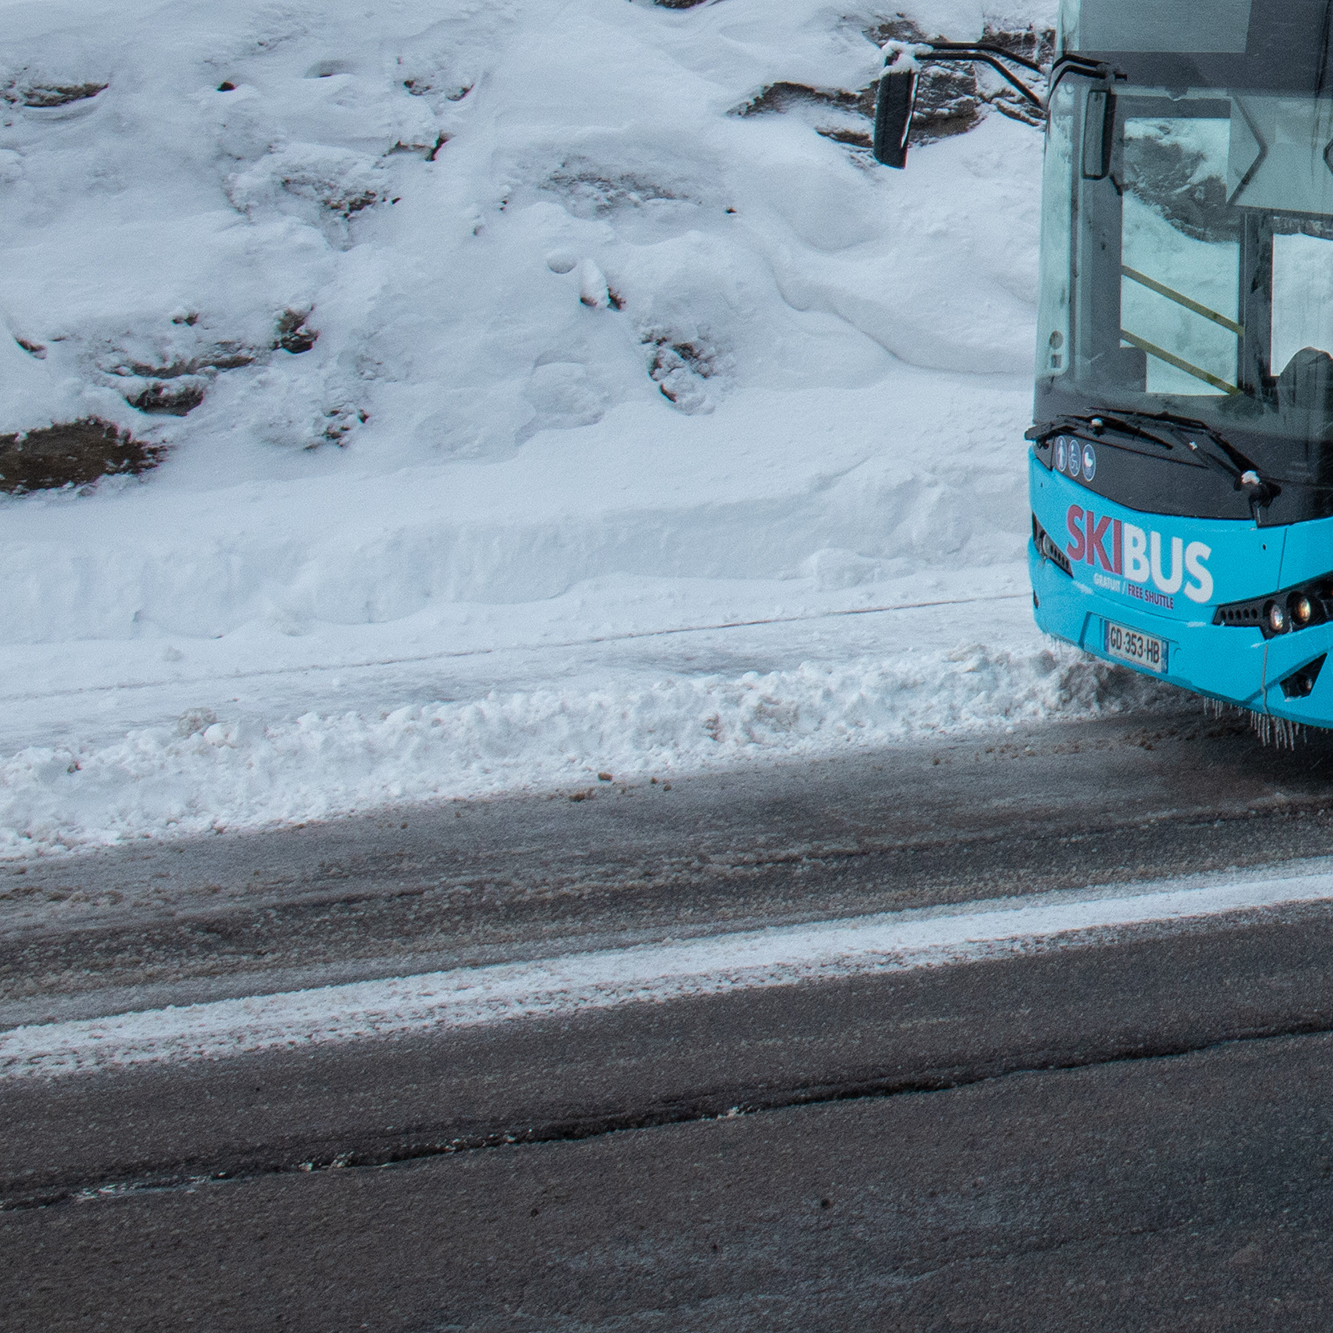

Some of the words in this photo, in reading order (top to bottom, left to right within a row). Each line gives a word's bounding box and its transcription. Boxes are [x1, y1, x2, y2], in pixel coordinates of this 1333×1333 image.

[1066, 504, 1214, 604] SKIBUS
[1093, 573, 1121, 593] GRATUIT
[1128, 583, 1143, 600] FREE
[1144, 589, 1174, 610] SHUTTLE
[1110, 626, 1160, 664] GD-353-HB
